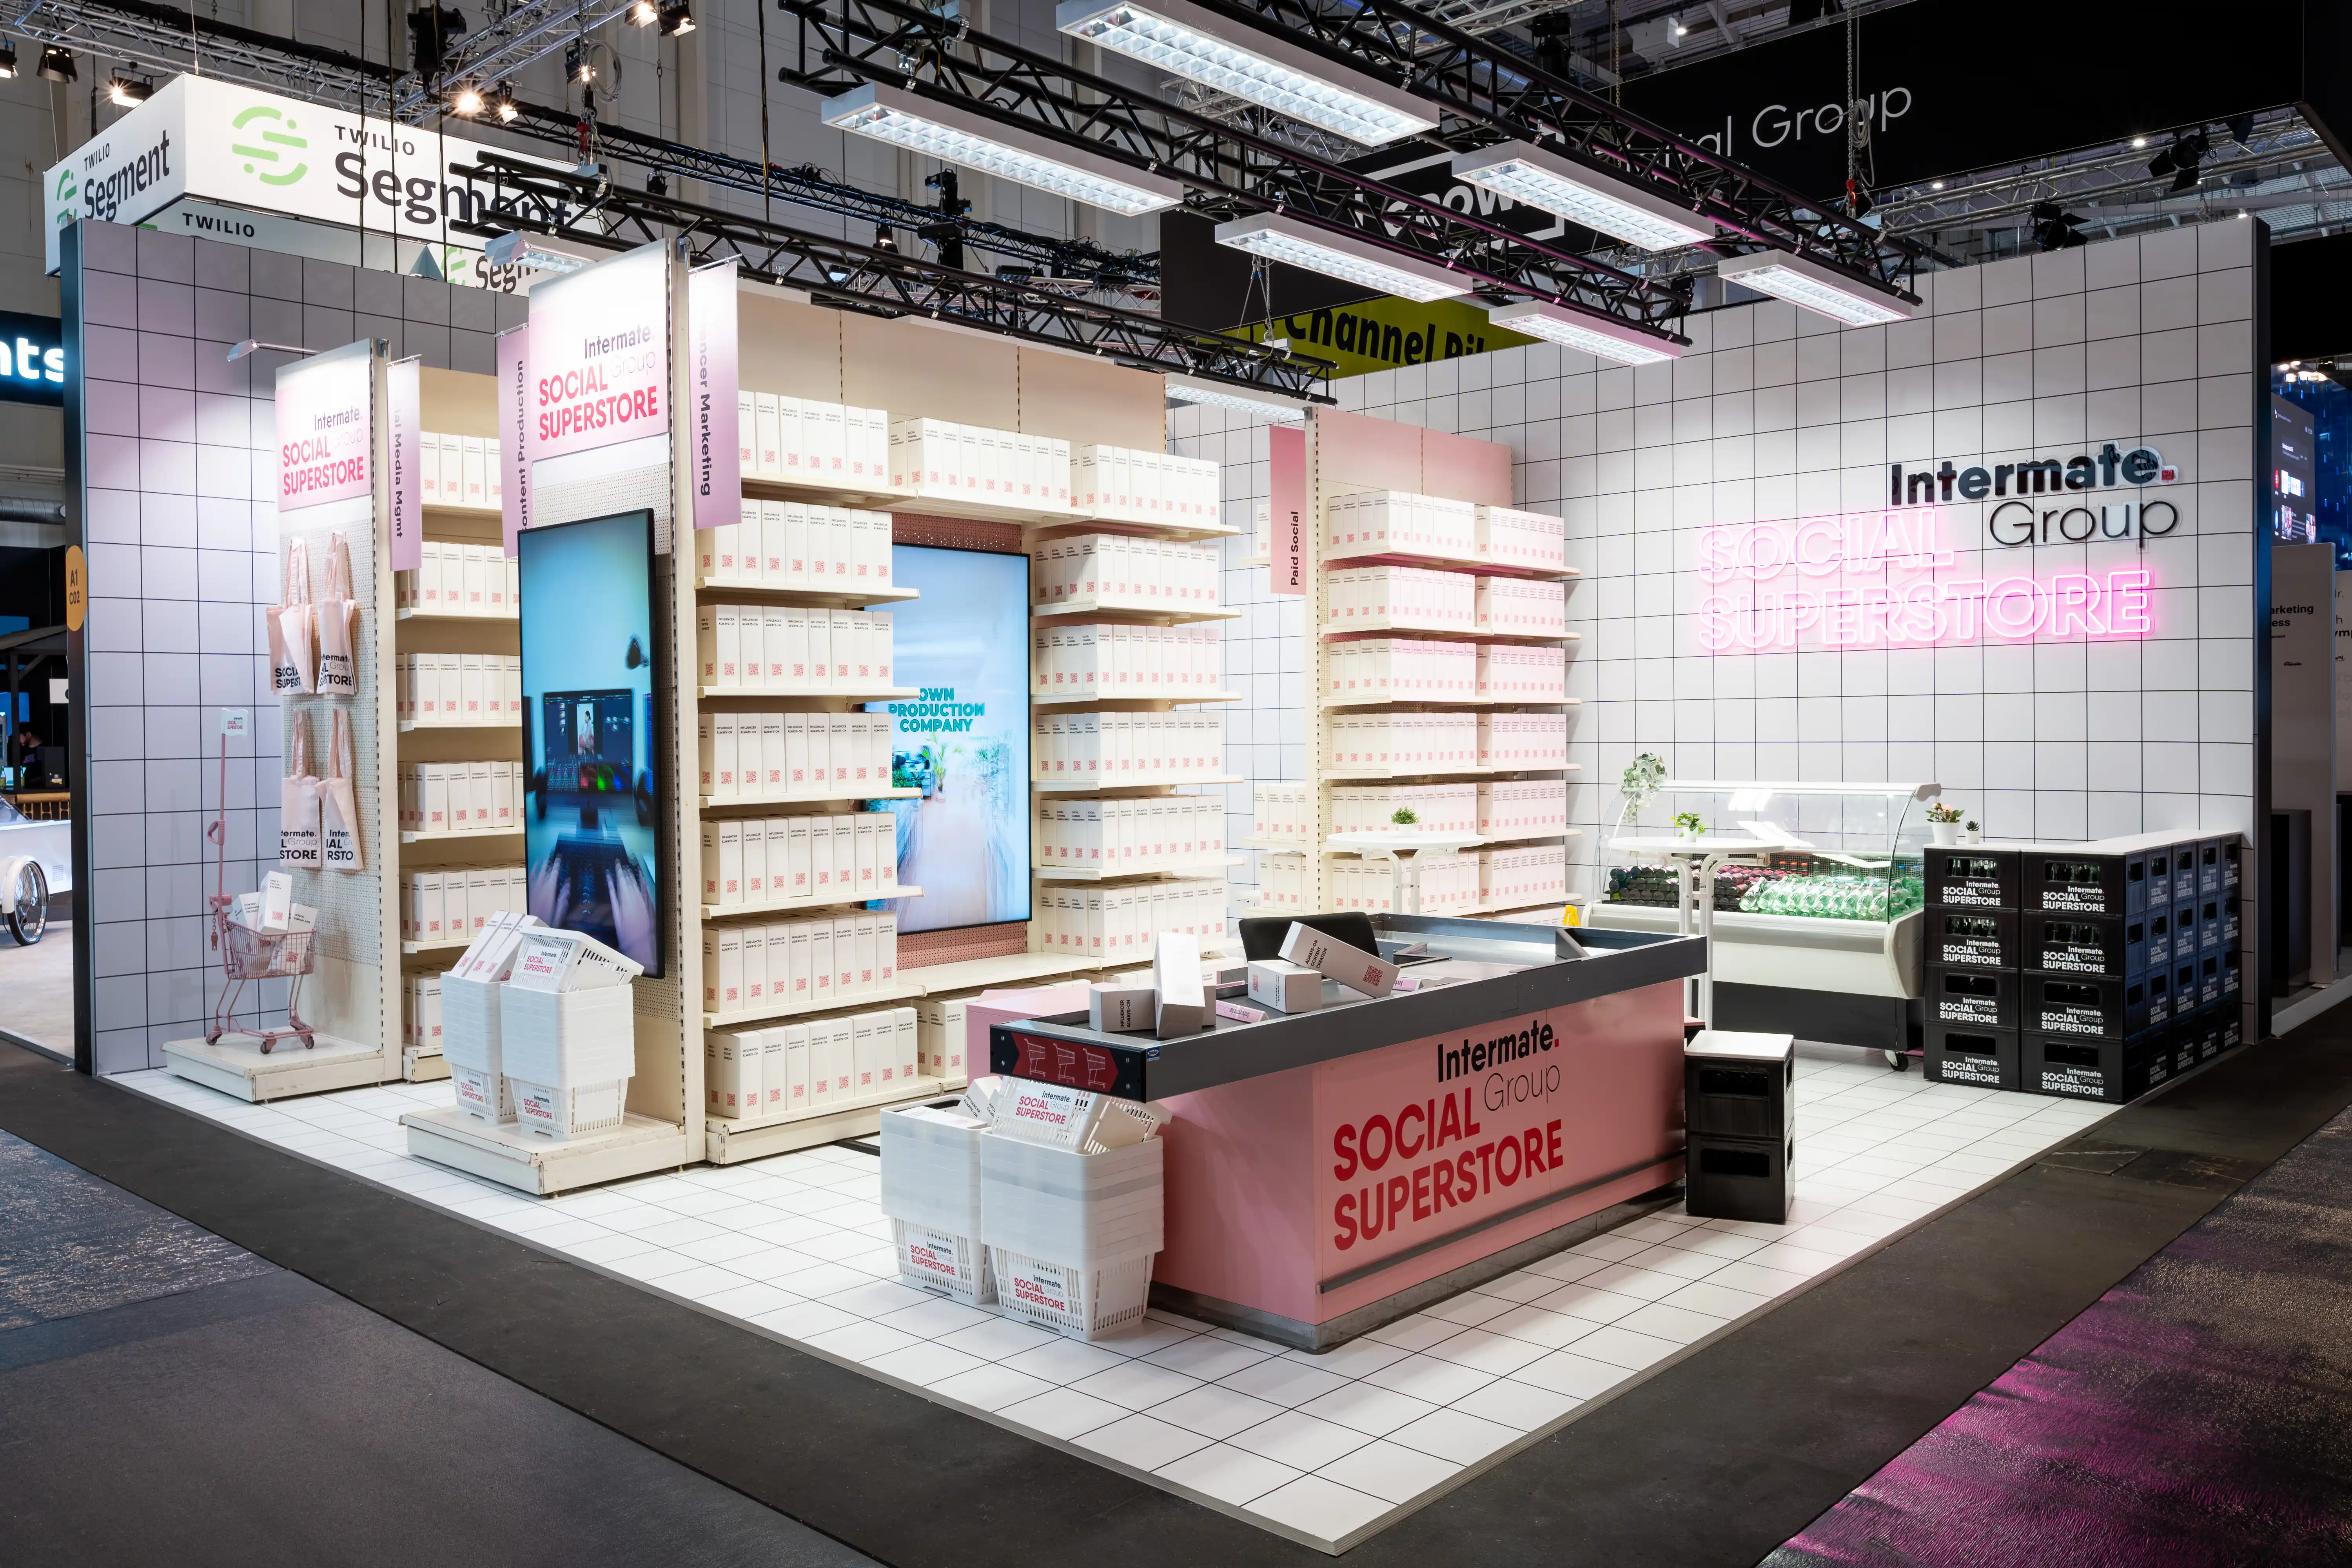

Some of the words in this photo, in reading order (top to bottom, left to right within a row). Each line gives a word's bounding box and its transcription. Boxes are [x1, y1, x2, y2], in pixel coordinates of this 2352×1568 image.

[1753, 87, 1912, 149] Group
[334, 125, 415, 156] TWILIO
[84, 143, 110, 172] TWILIO
[84, 130, 170, 222] Segment
[182, 213, 255, 238] TWILIO
[585, 324, 655, 359] Intermate.
[610, 350, 655, 377] Group
[539, 363, 608, 407] SOCIAL
[314, 406, 363, 431] Intermate.
[517, 360, 525, 462] Production
[539, 386, 657, 441] SUPERSTORE
[283, 435, 330, 467] SOCIAL
[701, 394, 710, 496] Marketing
[283, 457, 364, 495] SUPERSTORE
[1891, 444, 2174, 506] Intermate.
[519, 468, 528, 530] ontent
[394, 491, 403, 538] Mgmt
[1989, 499, 2178, 549] Group
[1698, 508, 1955, 583] SOCIAL
[70, 569, 78, 587] A1
[1699, 569, 2153, 650] SUPERSTORE
[2271, 605, 2314, 615] arketing
[330, 661, 348, 671] Grou
[919, 688, 954, 701] OWN
[888, 703, 985, 717] PRODUCTION
[900, 719, 973, 732] COMPANY
[288, 838, 317, 847] Group
[1943, 887, 1978, 896] SOCIAL
[2043, 892, 2080, 902] SOCIAL
[1943, 895, 2000, 906] SUPERSTORE
[2043, 901, 2105, 912] SUPERSTORE
[1943, 945, 1978, 954] SOCIAL
[1967, 939, 2000, 947] Intermate.
[2068, 946, 2104, 955] Intermate.
[527, 955, 544, 964] SOCIAL
[1305, 940, 1318, 964] ALWAYS-ON
[1311, 947, 1321, 966] CONTENT
[1316, 948, 1328, 969] CREATION
[1943, 953, 2000, 965] SUPERSTORE
[2043, 951, 2080, 962] SOCIAL
[2081, 953, 2104, 962] Group
[524, 963, 553, 973] SUPERSTORE
[2043, 960, 2105, 973] SUPERSTORE
[1940, 1002, 1975, 1013] SOCIAL
[1975, 1005, 1997, 1013] Group
[1963, 998, 1997, 1006] Intermate.
[1940, 1011, 1997, 1024] SUPERSTORE
[2042, 1012, 2079, 1023] SOCIAL
[2080, 1015, 2103, 1023] Group
[2067, 1007, 2103, 1016] Intermate.
[2042, 1021, 2103, 1034] SUPERSTORE
[1437, 1020, 1559, 1083] Intermate.
[1942, 1061, 1977, 1072] SOCIAL
[1977, 1064, 1999, 1073] Group
[1965, 1056, 1999, 1066] Intermate.
[1942, 1069, 1999, 1083] SUPERSTORE
[461, 1082, 474, 1092] SOCIAL
[462, 1090, 484, 1102] SUPERSTORE
[524, 1098, 541, 1109] SOCIAL
[534, 1095, 550, 1103] Intermate.
[966, 1094, 980, 1113] INFLUENCER
[1019, 1096, 1048, 1110] SOCIAL
[1051, 1100, 1069, 1111] Group
[1042, 1091, 1071, 1103] Intermate.
[525, 1107, 553, 1120] SUPERSTORE
[964, 1099, 978, 1118] ALWAYS-ON
[1016, 1107, 1066, 1125] SUPERSTORE
[1334, 1087, 1480, 1181] SOCIAL
[1484, 1065, 1560, 1111] Group
[1334, 1119, 1563, 1251] SUPERSTORE
[911, 1245, 937, 1260] SOCIAL
[937, 1252, 954, 1263] Group
[927, 1241, 953, 1255] Intermate.
[911, 1254, 955, 1276] SUPERSTORE
[1014, 1277, 1044, 1294] SOCIAL
[1044, 1285, 1063, 1298] Group
[1033, 1274, 1063, 1290] Intermate.
[1016, 1288, 1065, 1311] SUPERSTORE
